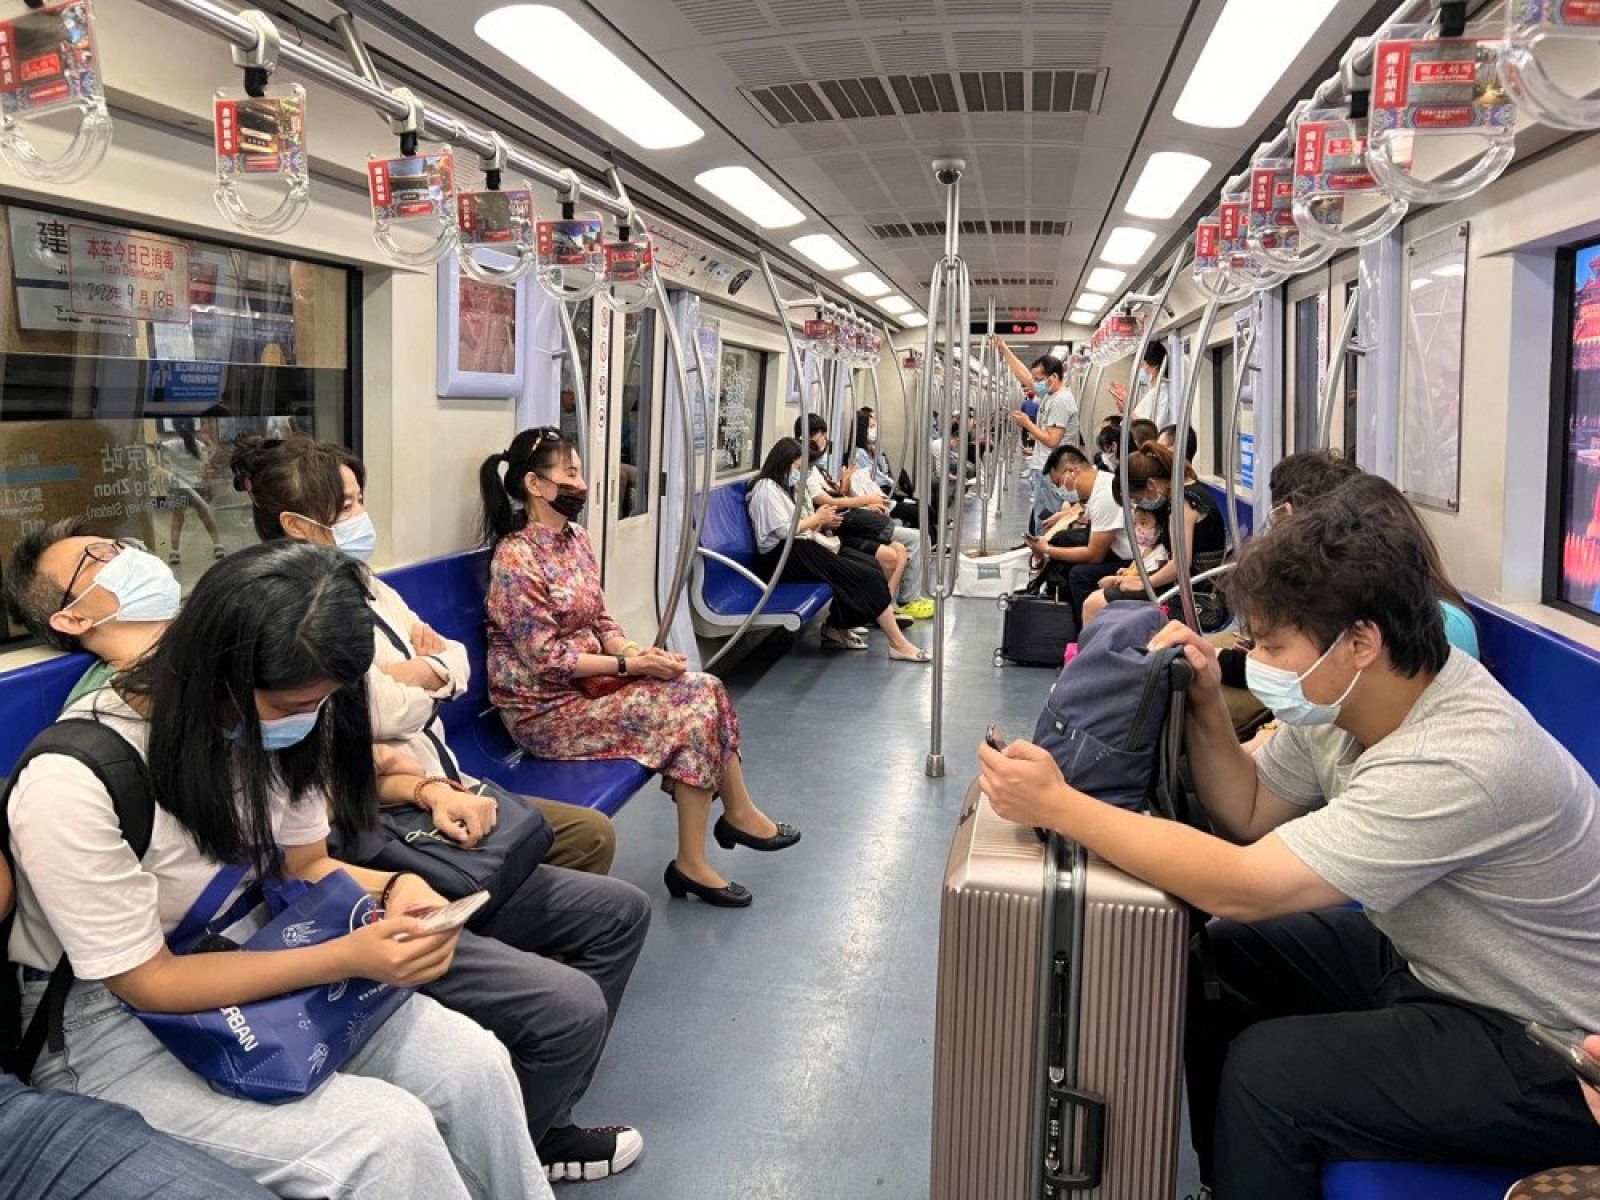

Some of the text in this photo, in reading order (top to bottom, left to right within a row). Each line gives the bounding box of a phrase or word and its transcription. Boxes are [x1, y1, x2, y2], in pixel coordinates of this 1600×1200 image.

[87, 236, 175, 271] 本车今日已消毒
[220, 1006, 259, 1052] RBAN
